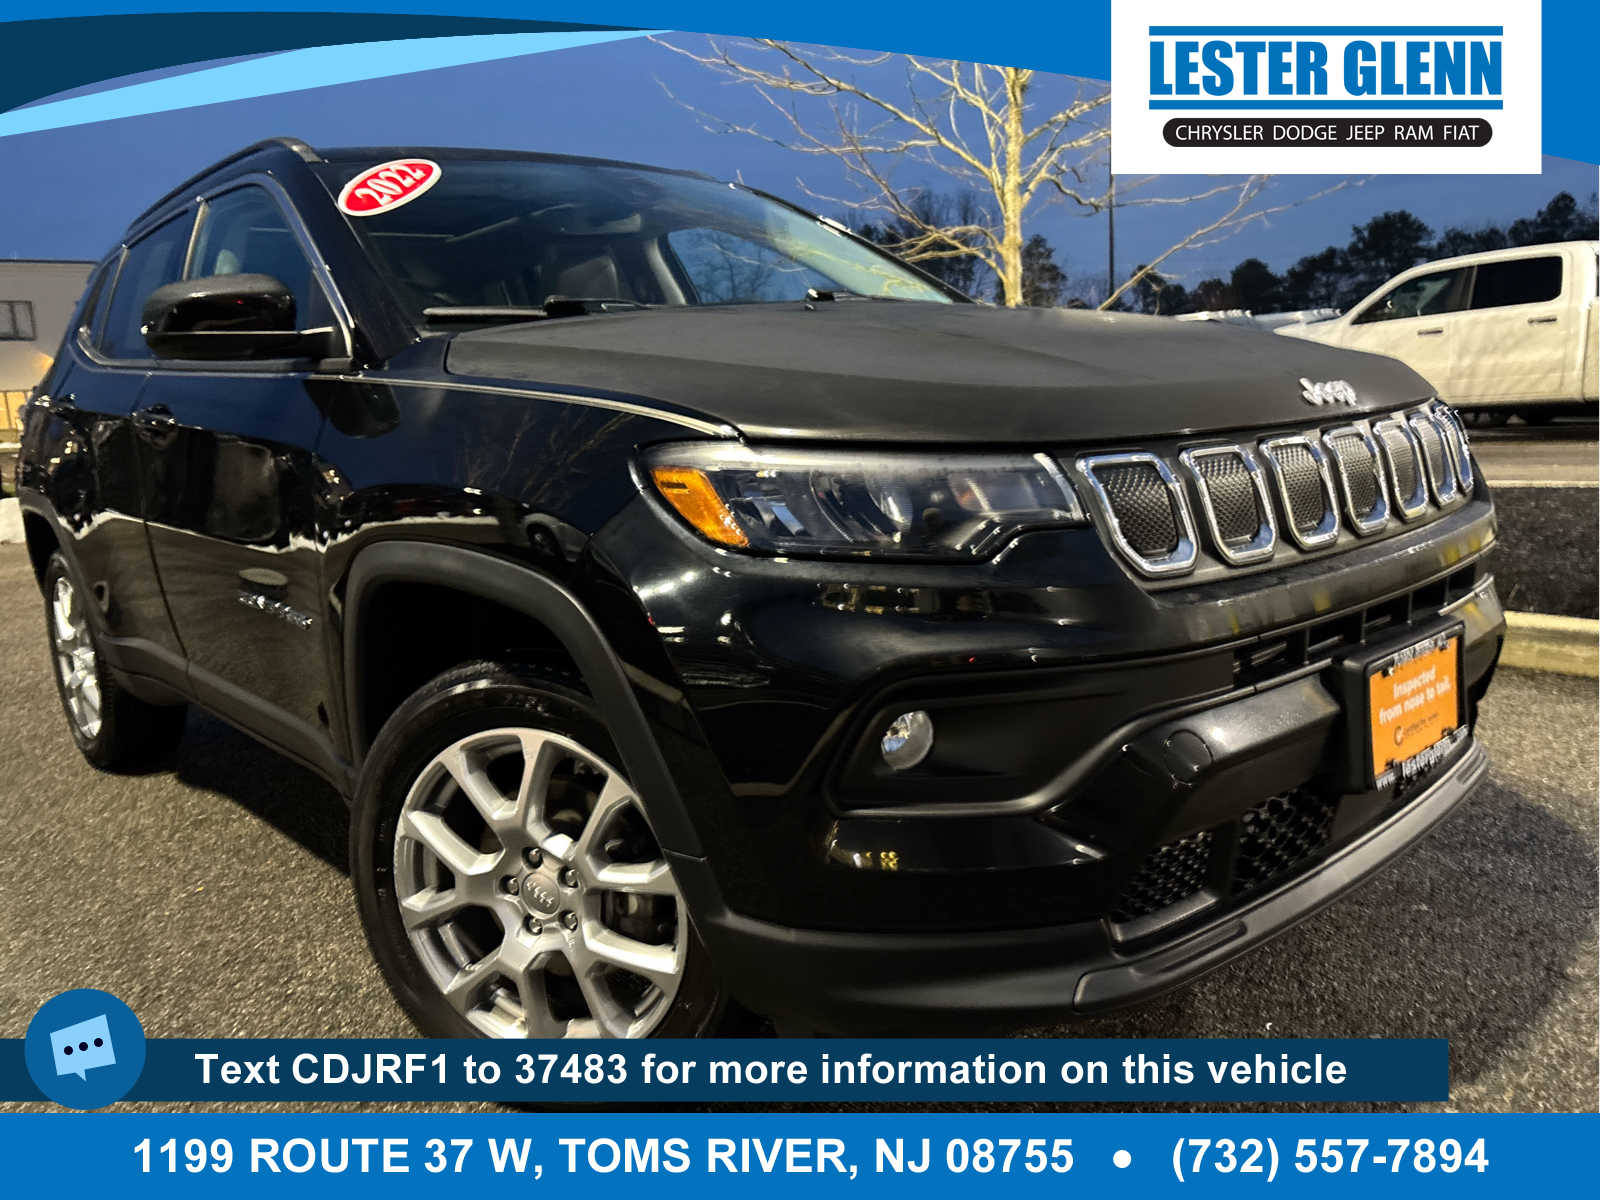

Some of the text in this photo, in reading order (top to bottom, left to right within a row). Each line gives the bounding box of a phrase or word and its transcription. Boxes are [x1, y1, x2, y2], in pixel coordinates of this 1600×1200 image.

[355, 165, 426, 206] 2022
[1299, 377, 1357, 406] Jeep
[1393, 664, 1436, 699] Inspected
[1379, 702, 1403, 725] from
[1404, 692, 1425, 712] nose
[1426, 685, 1435, 700] to
